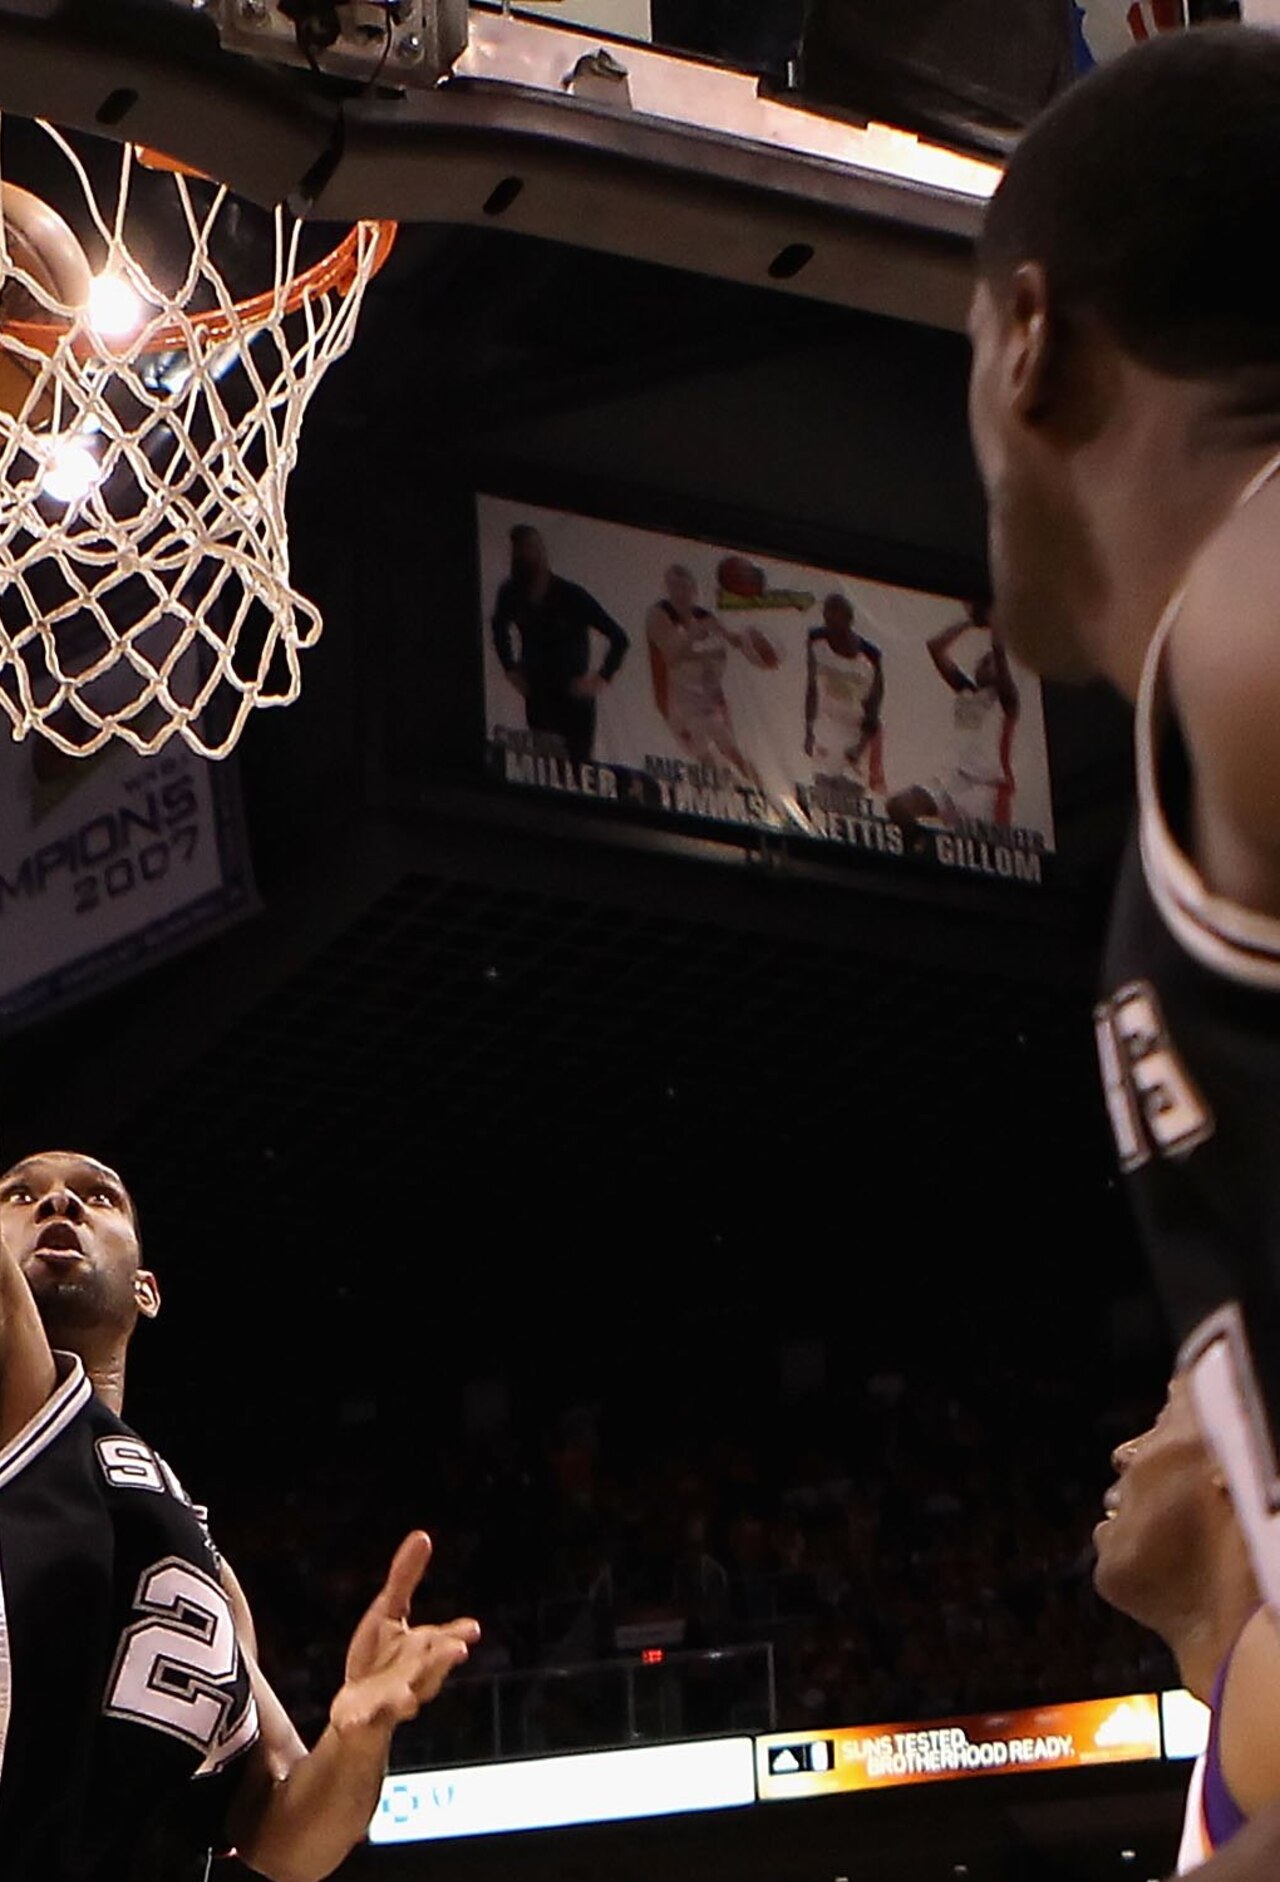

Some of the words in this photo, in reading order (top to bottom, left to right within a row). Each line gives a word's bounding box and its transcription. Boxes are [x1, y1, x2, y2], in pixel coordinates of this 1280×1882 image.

[504, 748, 620, 801] MILLER
[934, 831, 1045, 885] GILLOM
[73, 824, 200, 914] 2007
[841, 1735, 893, 1762] SUNS
[866, 1742, 1007, 1778] BROTHERHOOD
